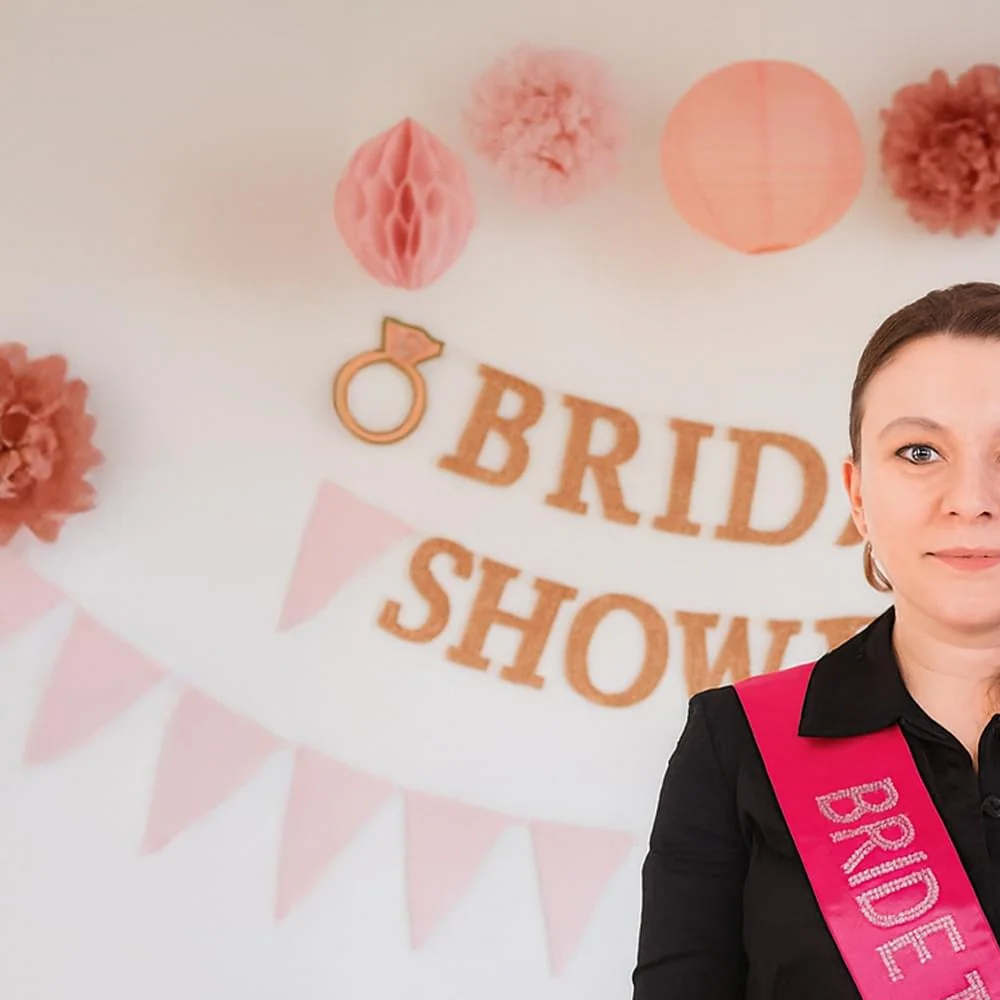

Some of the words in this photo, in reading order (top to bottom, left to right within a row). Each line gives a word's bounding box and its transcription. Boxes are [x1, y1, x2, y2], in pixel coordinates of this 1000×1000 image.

[437, 362, 865, 547] BRID
[377, 535, 878, 708] SHOW
[815, 777, 966, 982] BRIDE
